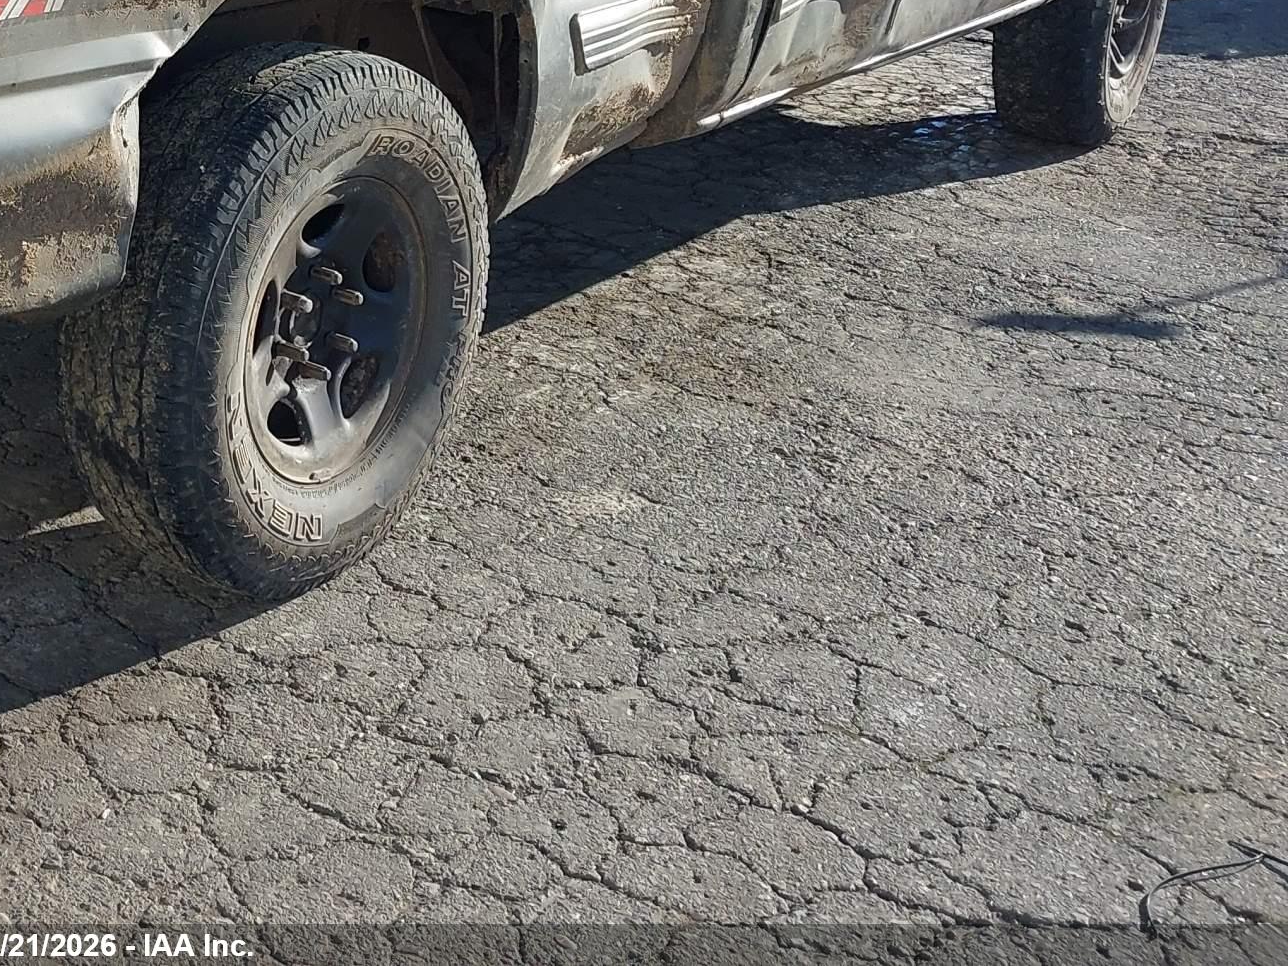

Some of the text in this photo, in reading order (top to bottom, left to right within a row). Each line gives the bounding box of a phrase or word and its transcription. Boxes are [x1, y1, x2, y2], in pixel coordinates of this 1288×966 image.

[367, 133, 472, 317] ROADIAN AT
[225, 391, 323, 542] NEXEN
